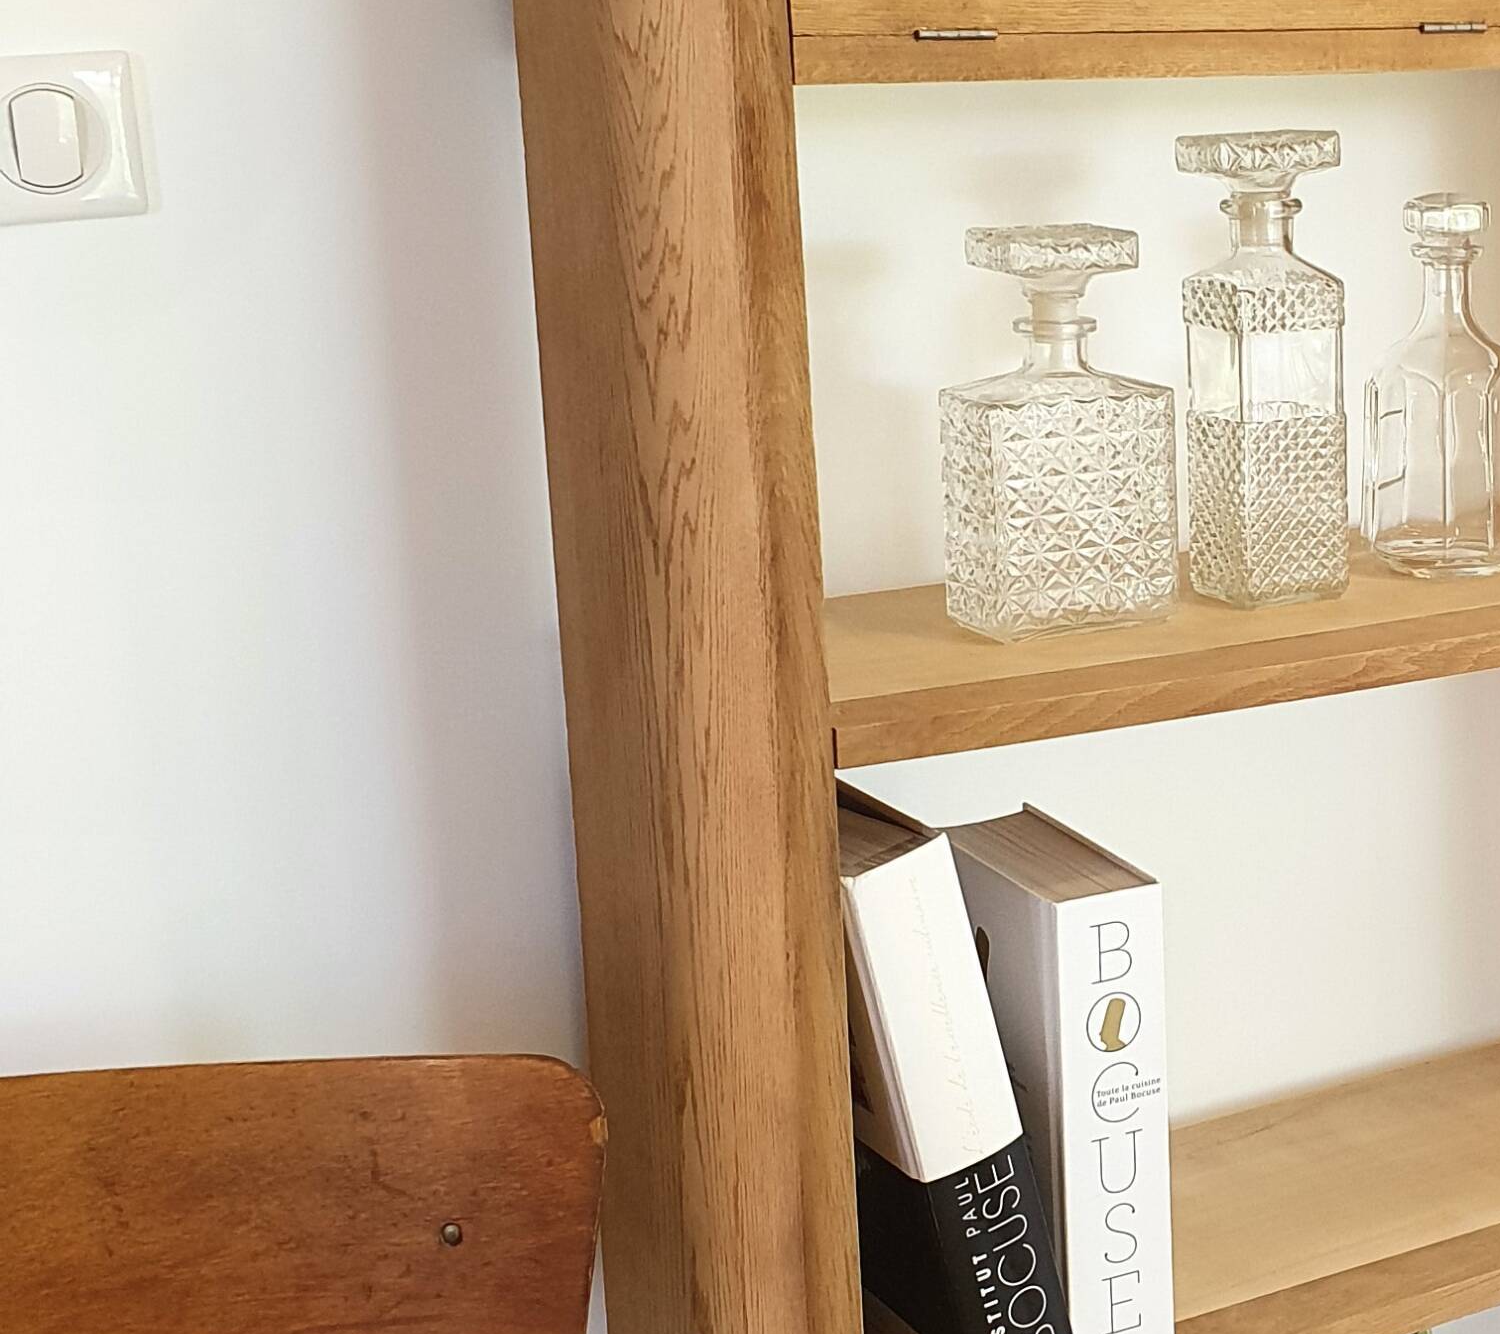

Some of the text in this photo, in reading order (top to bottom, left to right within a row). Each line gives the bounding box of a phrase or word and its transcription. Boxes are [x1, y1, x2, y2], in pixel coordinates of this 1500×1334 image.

[1096, 1077, 1162, 1098] Toute la cuisine
[1096, 1086, 1162, 1108] de Paul Bocuse
[954, 1176, 982, 1239] PAUL
